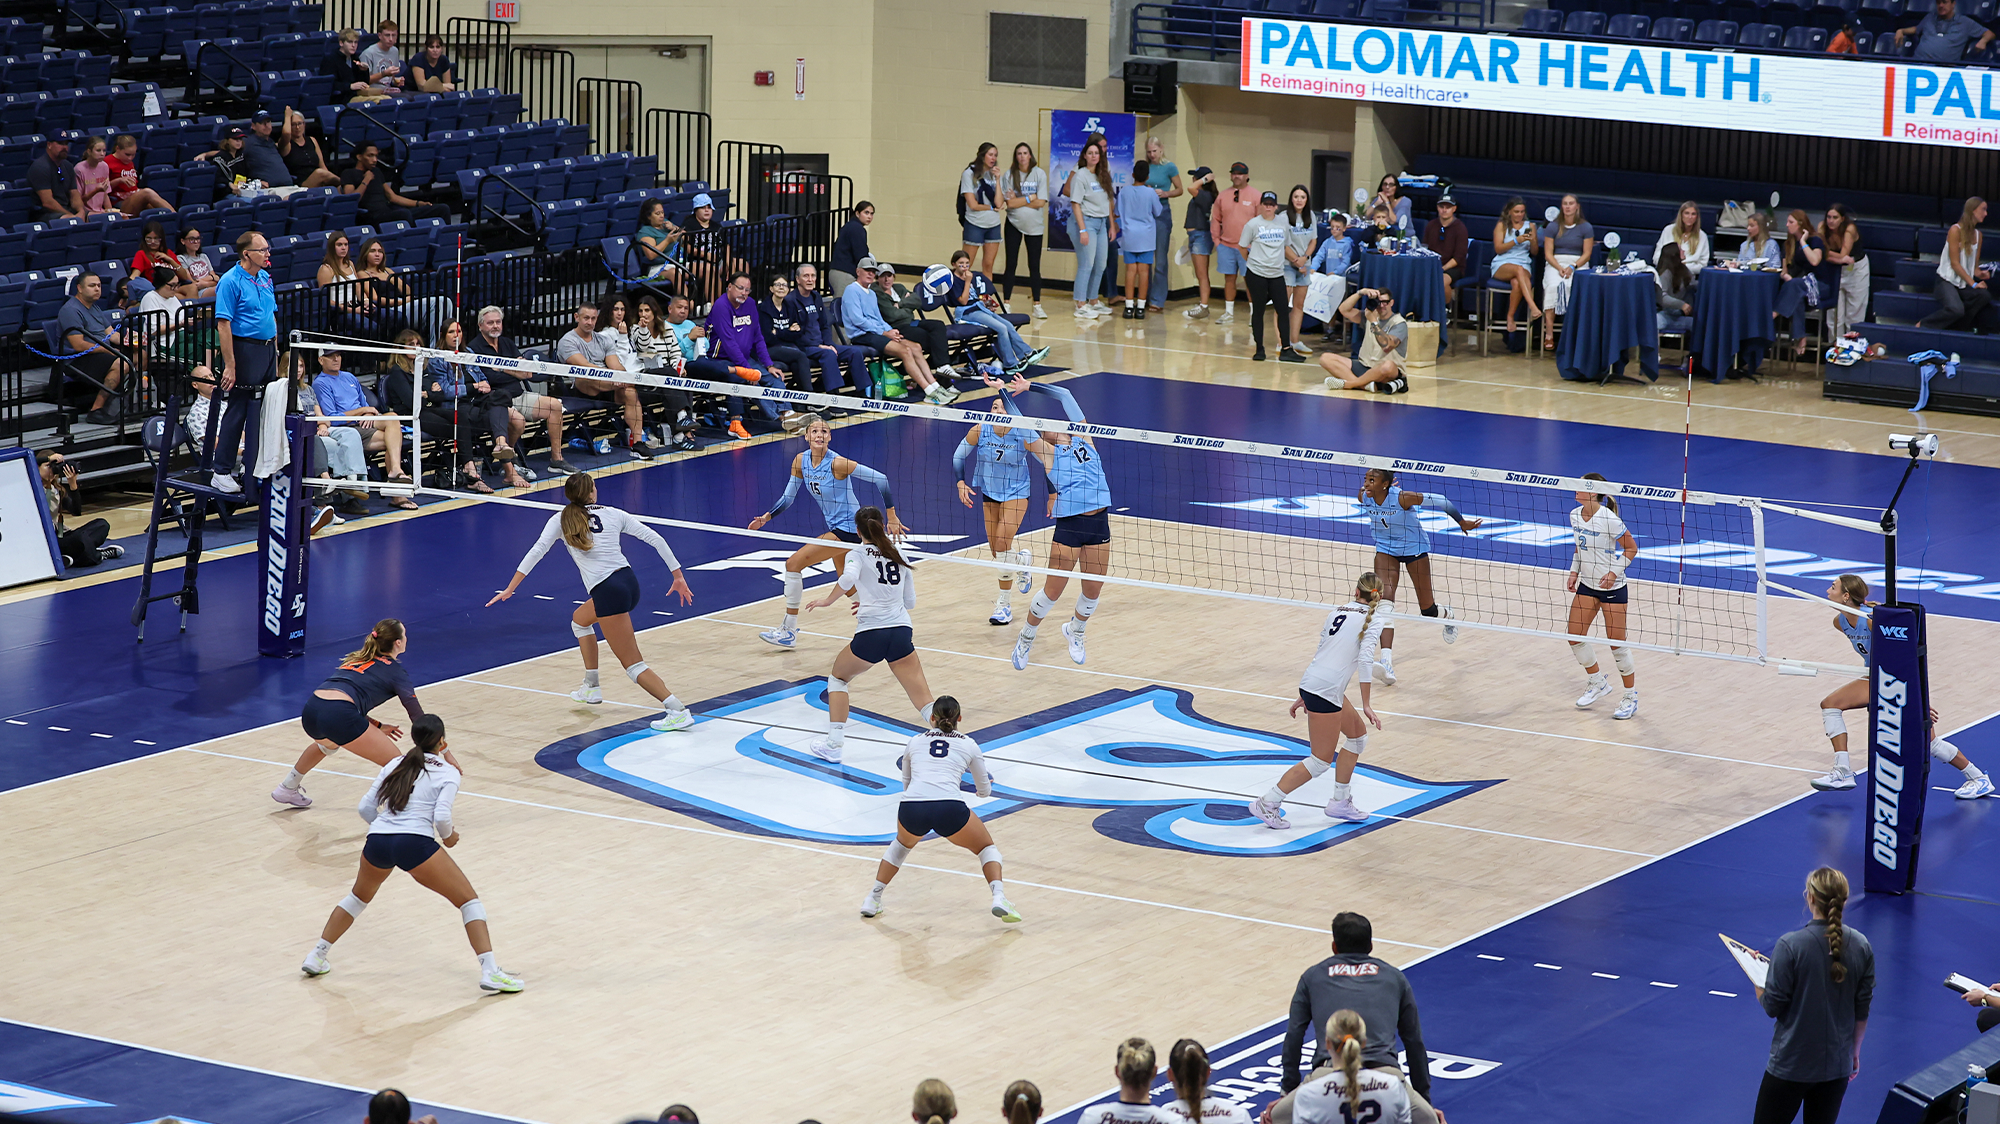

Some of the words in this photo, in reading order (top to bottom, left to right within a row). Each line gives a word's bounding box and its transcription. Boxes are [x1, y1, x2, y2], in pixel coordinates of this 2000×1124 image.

[495, 2, 516, 18] EXIT
[1261, 22, 1520, 84] PALOMAR
[1261, 73, 1366, 98] Reimagining
[474, 354, 492, 364] SAN
[493, 357, 519, 368] DIEGO
[568, 366, 587, 374] SAN
[588, 368, 614, 378] DIEGO
[664, 377, 683, 386] SAN
[685, 380, 710, 390] DIEGO
[762, 388, 782, 398] SAN
[783, 392, 809, 400] DIEGO
[861, 400, 881, 409] SAN
[882, 402, 910, 412] DIEGO
[963, 411, 984, 421] SAN
[985, 414, 1012, 424] DIEGO
[1067, 422, 1088, 432] SAN
[1090, 426, 1117, 436] DIEGO
[1172, 434, 1194, 445] SAN
[1195, 437, 1224, 448] DIEGO
[995, 449, 1004, 461] 7
[1073, 446, 1091, 464] 12
[1281, 446, 1302, 457] SAN
[1304, 450, 1334, 460] DIEGO
[1392, 459, 1414, 470] SAN
[1415, 462, 1445, 472] DIEGO
[1506, 472, 1528, 484] SAN
[1530, 474, 1560, 486] DIEGO
[809, 481, 821, 495] 15
[1620, 484, 1644, 496] SAN
[1646, 488, 1676, 499] DIEGO
[269, 470, 292, 540] SAN
[1380, 517, 1390, 529] 1
[1578, 535, 1588, 551] 2
[875, 560, 901, 585] 18
[265, 535, 288, 637] DIEGO
[1328, 614, 1347, 636] 9
[1879, 625, 1909, 638] WCC
[1877, 664, 1908, 757] SAN
[929, 738, 950, 759] 8
[1873, 750, 1905, 870] DIEGO
[1328, 962, 1379, 977] WAVES
